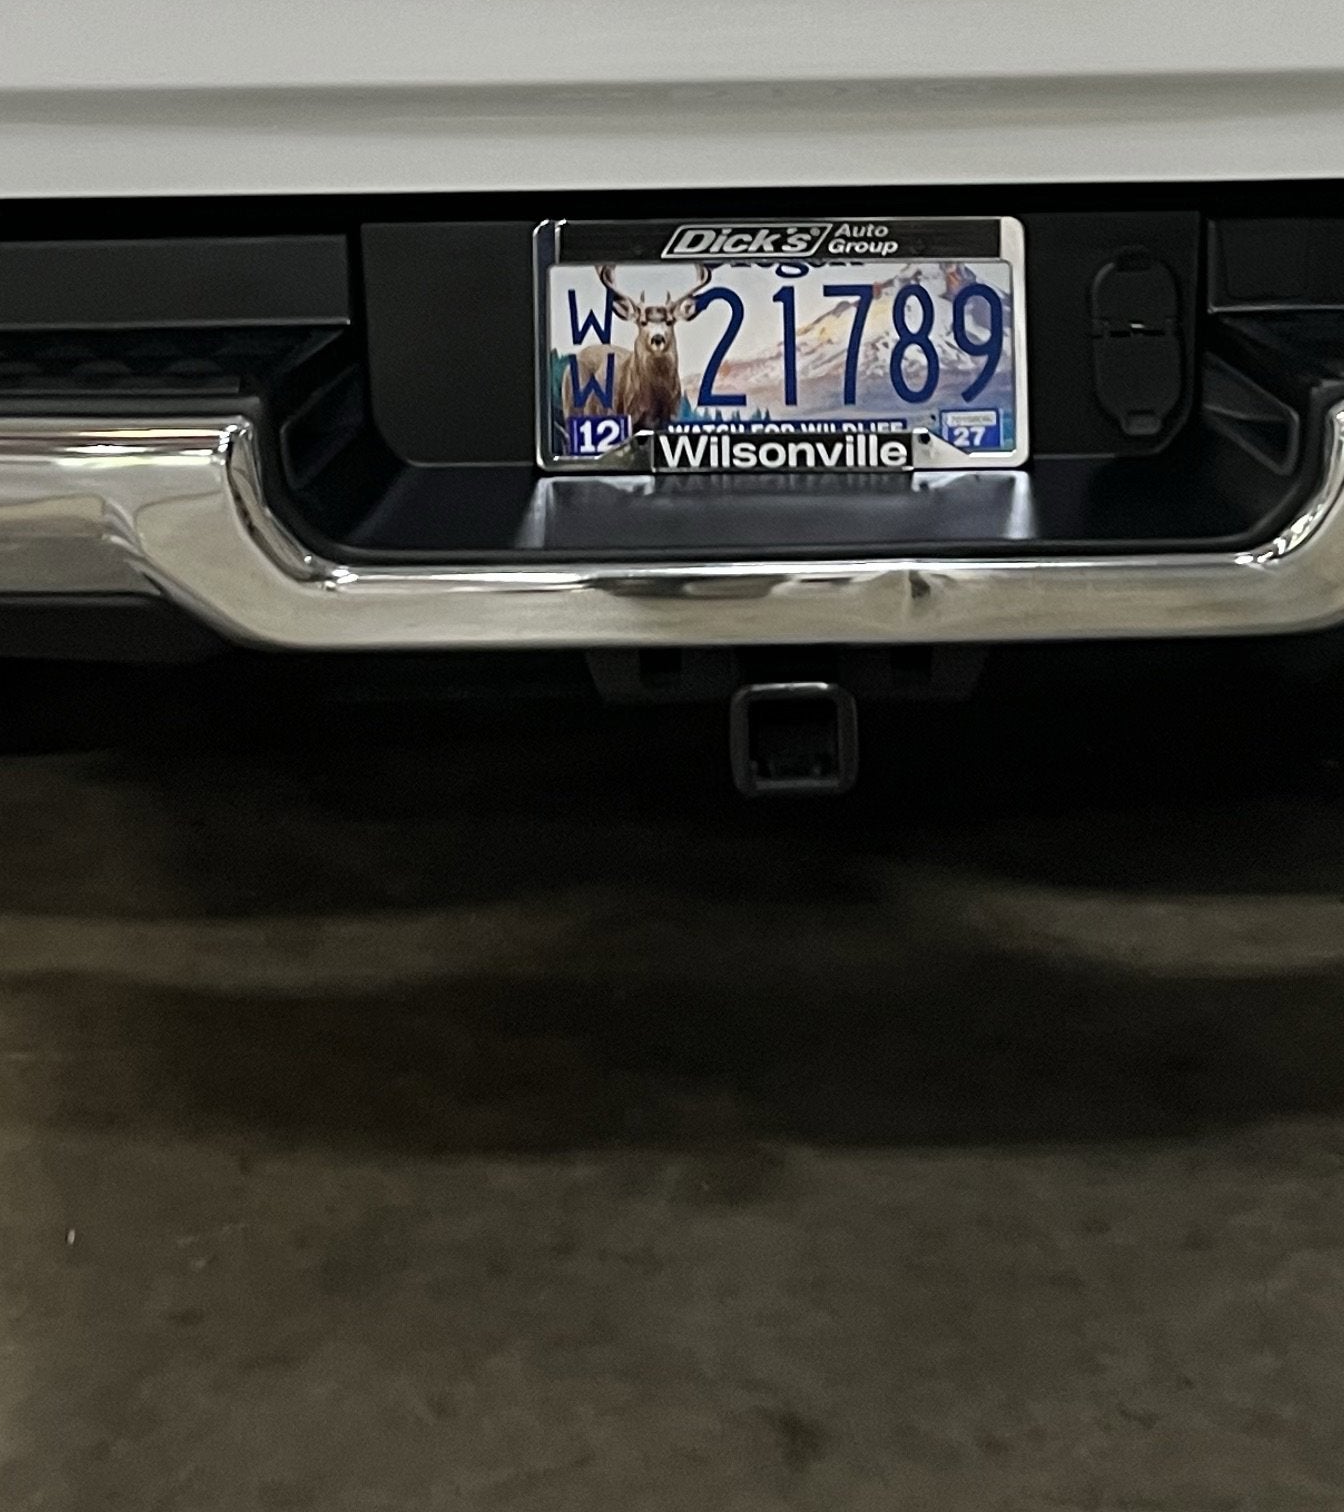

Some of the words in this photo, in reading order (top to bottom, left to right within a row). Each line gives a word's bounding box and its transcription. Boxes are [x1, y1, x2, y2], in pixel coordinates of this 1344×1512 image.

[673, 226, 812, 254] Dick's
[834, 223, 889, 238] Auto
[828, 238, 899, 256] Group
[579, 419, 621, 453] 12
[953, 427, 986, 446] 27
[659, 434, 907, 469] Wilsonville
